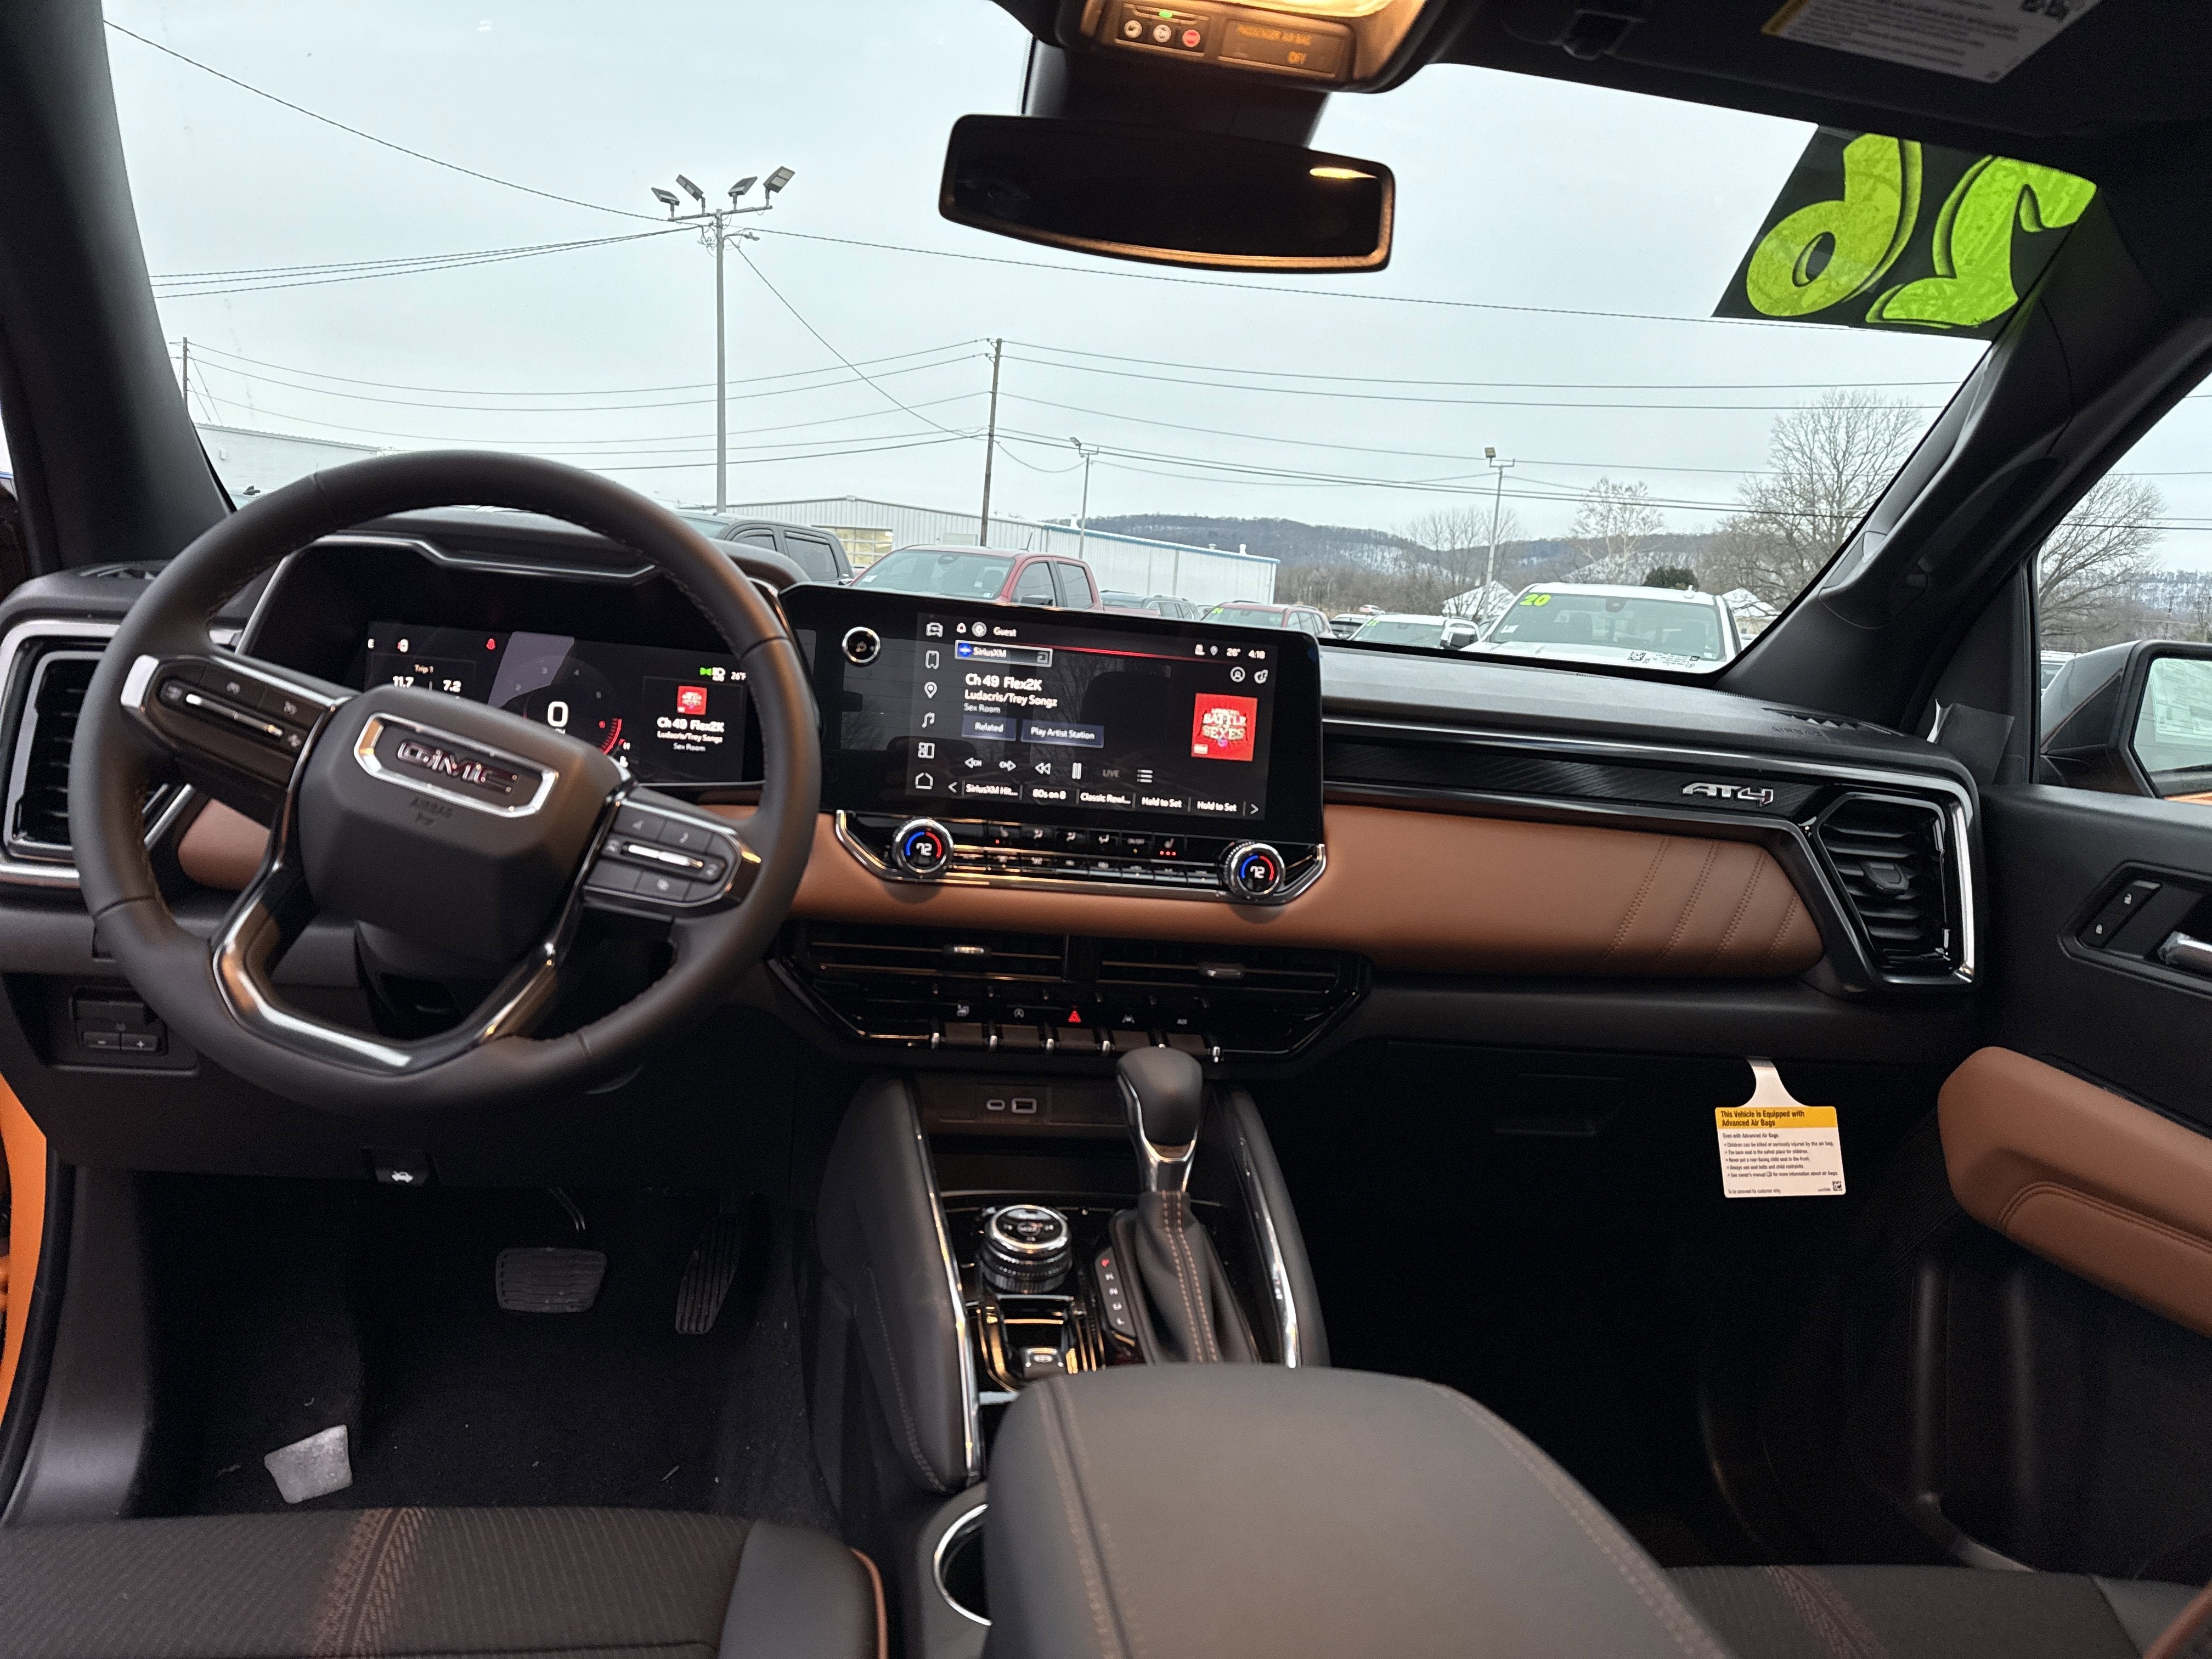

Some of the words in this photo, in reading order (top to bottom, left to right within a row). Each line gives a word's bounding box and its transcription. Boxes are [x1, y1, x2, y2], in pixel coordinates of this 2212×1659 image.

[1520, 594, 1551, 606] 20
[994, 627, 1017, 637] Guest
[368, 639, 375, 649] E
[973, 647, 1007, 658] SiriusXM
[414, 664, 428, 674] Trip
[393, 675, 414, 688] 11.7
[443, 680, 461, 692] 7.2
[966, 673, 981, 685] Ch
[983, 675, 999, 687] 49
[1004, 676, 1042, 691] Flex2K
[965, 689, 1028, 706] Ludacris/Trey
[1029, 695, 1057, 709] Songz
[548, 701, 568, 727] 0
[964, 703, 978, 712] Sex
[979, 703, 1001, 713] Room
[657, 717, 672, 728] Ch
[673, 719, 687, 729] 49
[690, 719, 724, 732] Flex2K
[1204, 713, 1246, 726] BATTLE
[975, 722, 1003, 732] Related
[1031, 726, 1047, 737] Play
[1047, 728, 1068, 737] Artist
[1069, 730, 1095, 740] Station
[1203, 725, 1245, 741] SEXES
[686, 743, 706, 752] Room
[397, 741, 518, 794] GMC
[1103, 769, 1120, 778] LIVE
[966, 783, 999, 794] SiriusXM
[1681, 782, 1774, 807] AT4
[1080, 792, 1105, 802] Classic
[1142, 797, 1160, 806] Hold
[1160, 798, 1169, 807] to
[1169, 799, 1182, 808] Set
[1197, 801, 1215, 810] Hold
[1216, 803, 1223, 811] to
[1224, 803, 1237, 812] Set
[916, 843, 932, 856] 72
[1250, 866, 1265, 879] 72
[1763, 1110, 1790, 1119] Equipped
